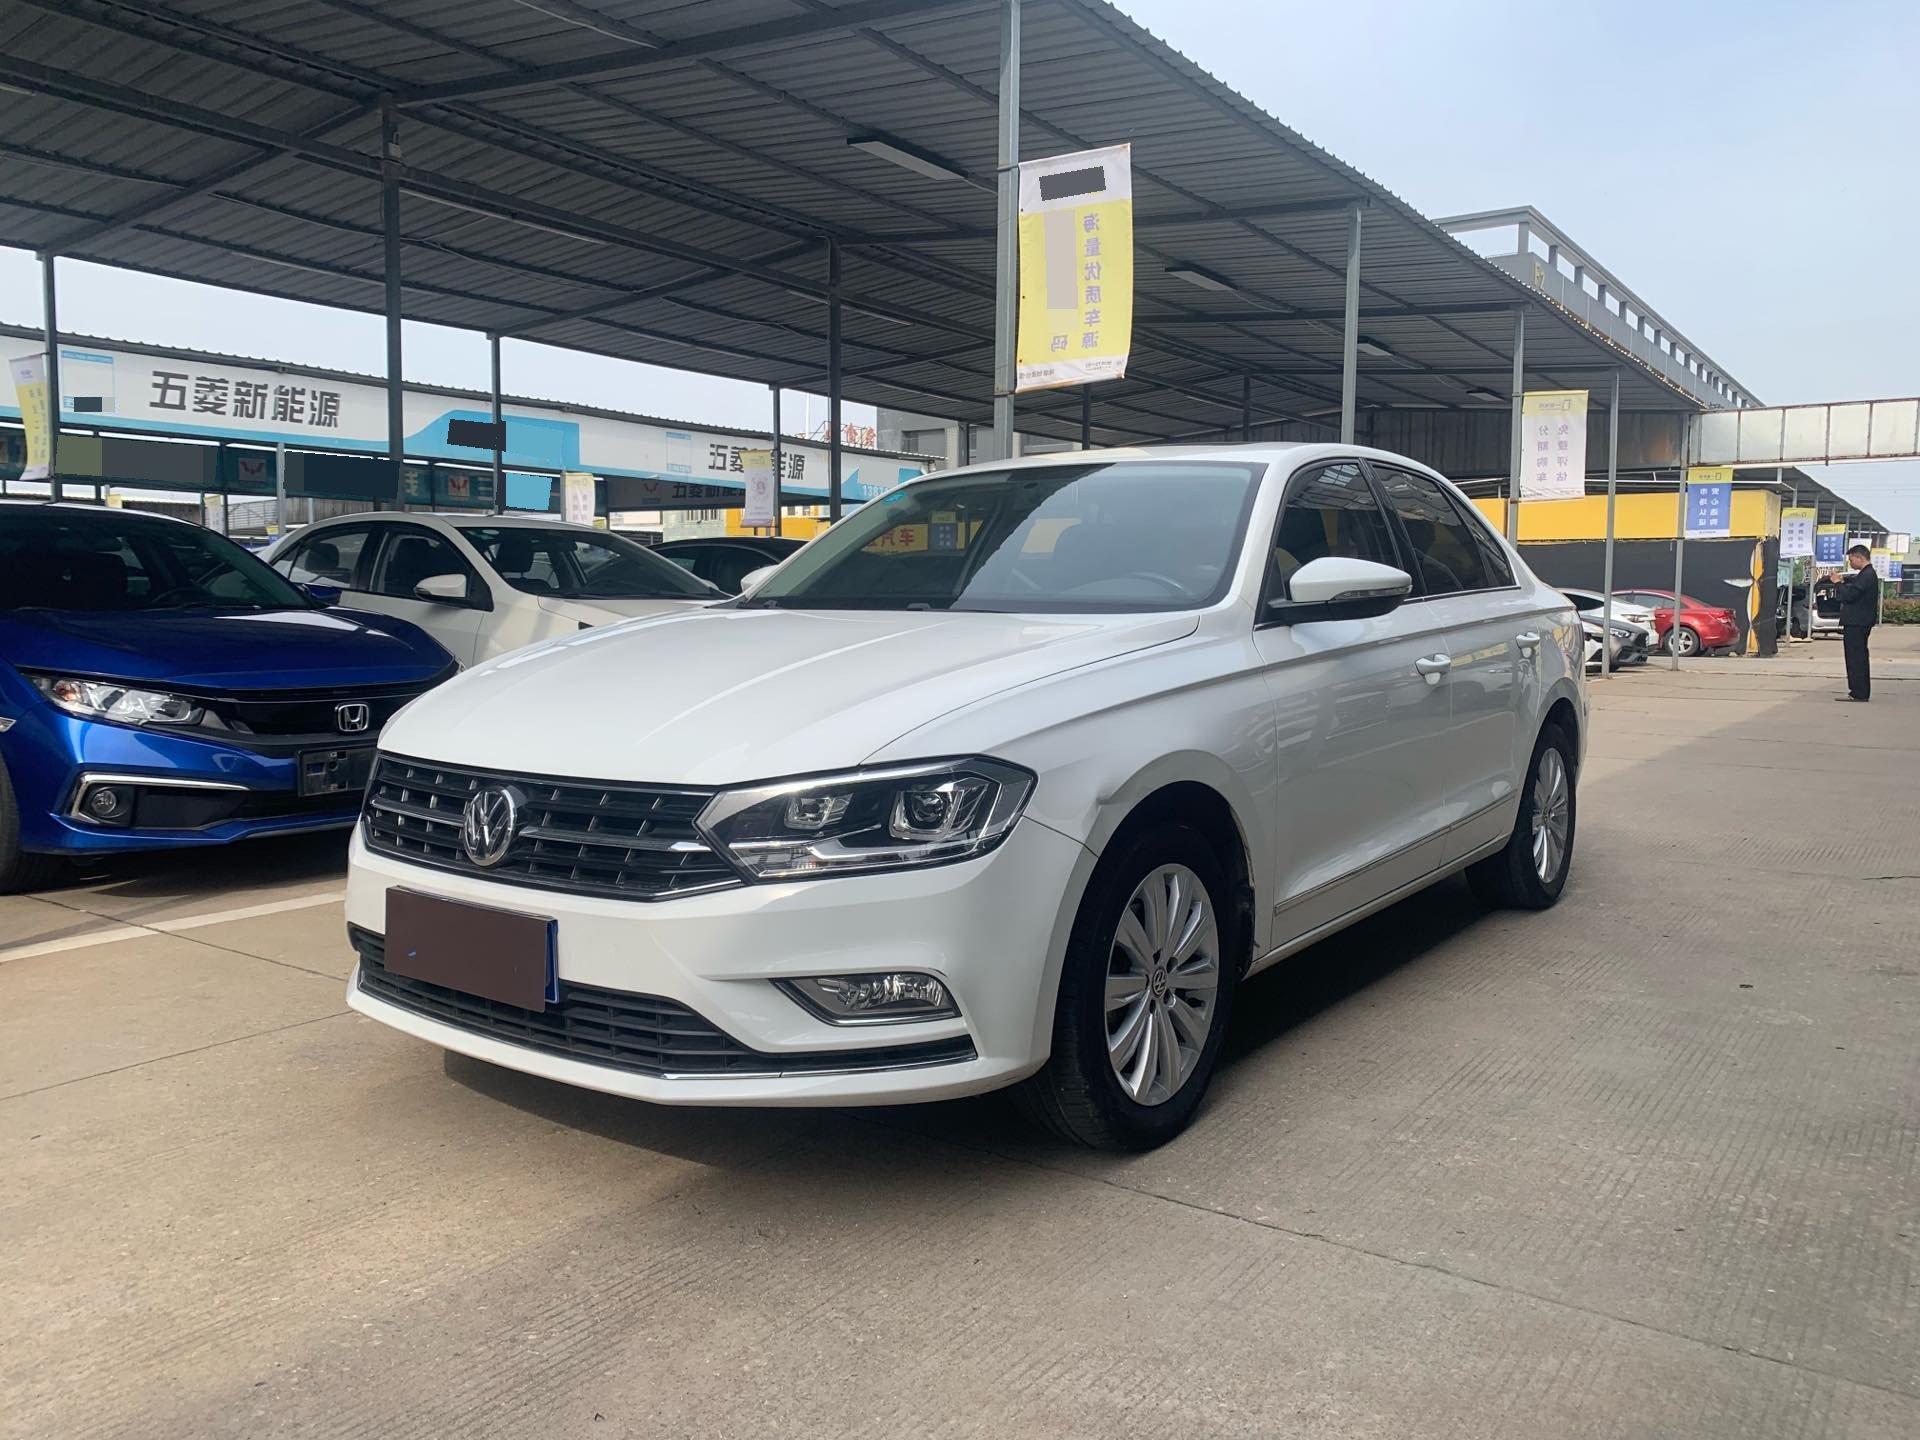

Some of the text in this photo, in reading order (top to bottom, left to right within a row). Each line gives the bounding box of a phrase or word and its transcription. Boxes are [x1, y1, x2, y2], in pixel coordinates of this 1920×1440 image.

[149, 370, 341, 429] 五菱新能源
[708, 443, 805, 480] 五菱源
